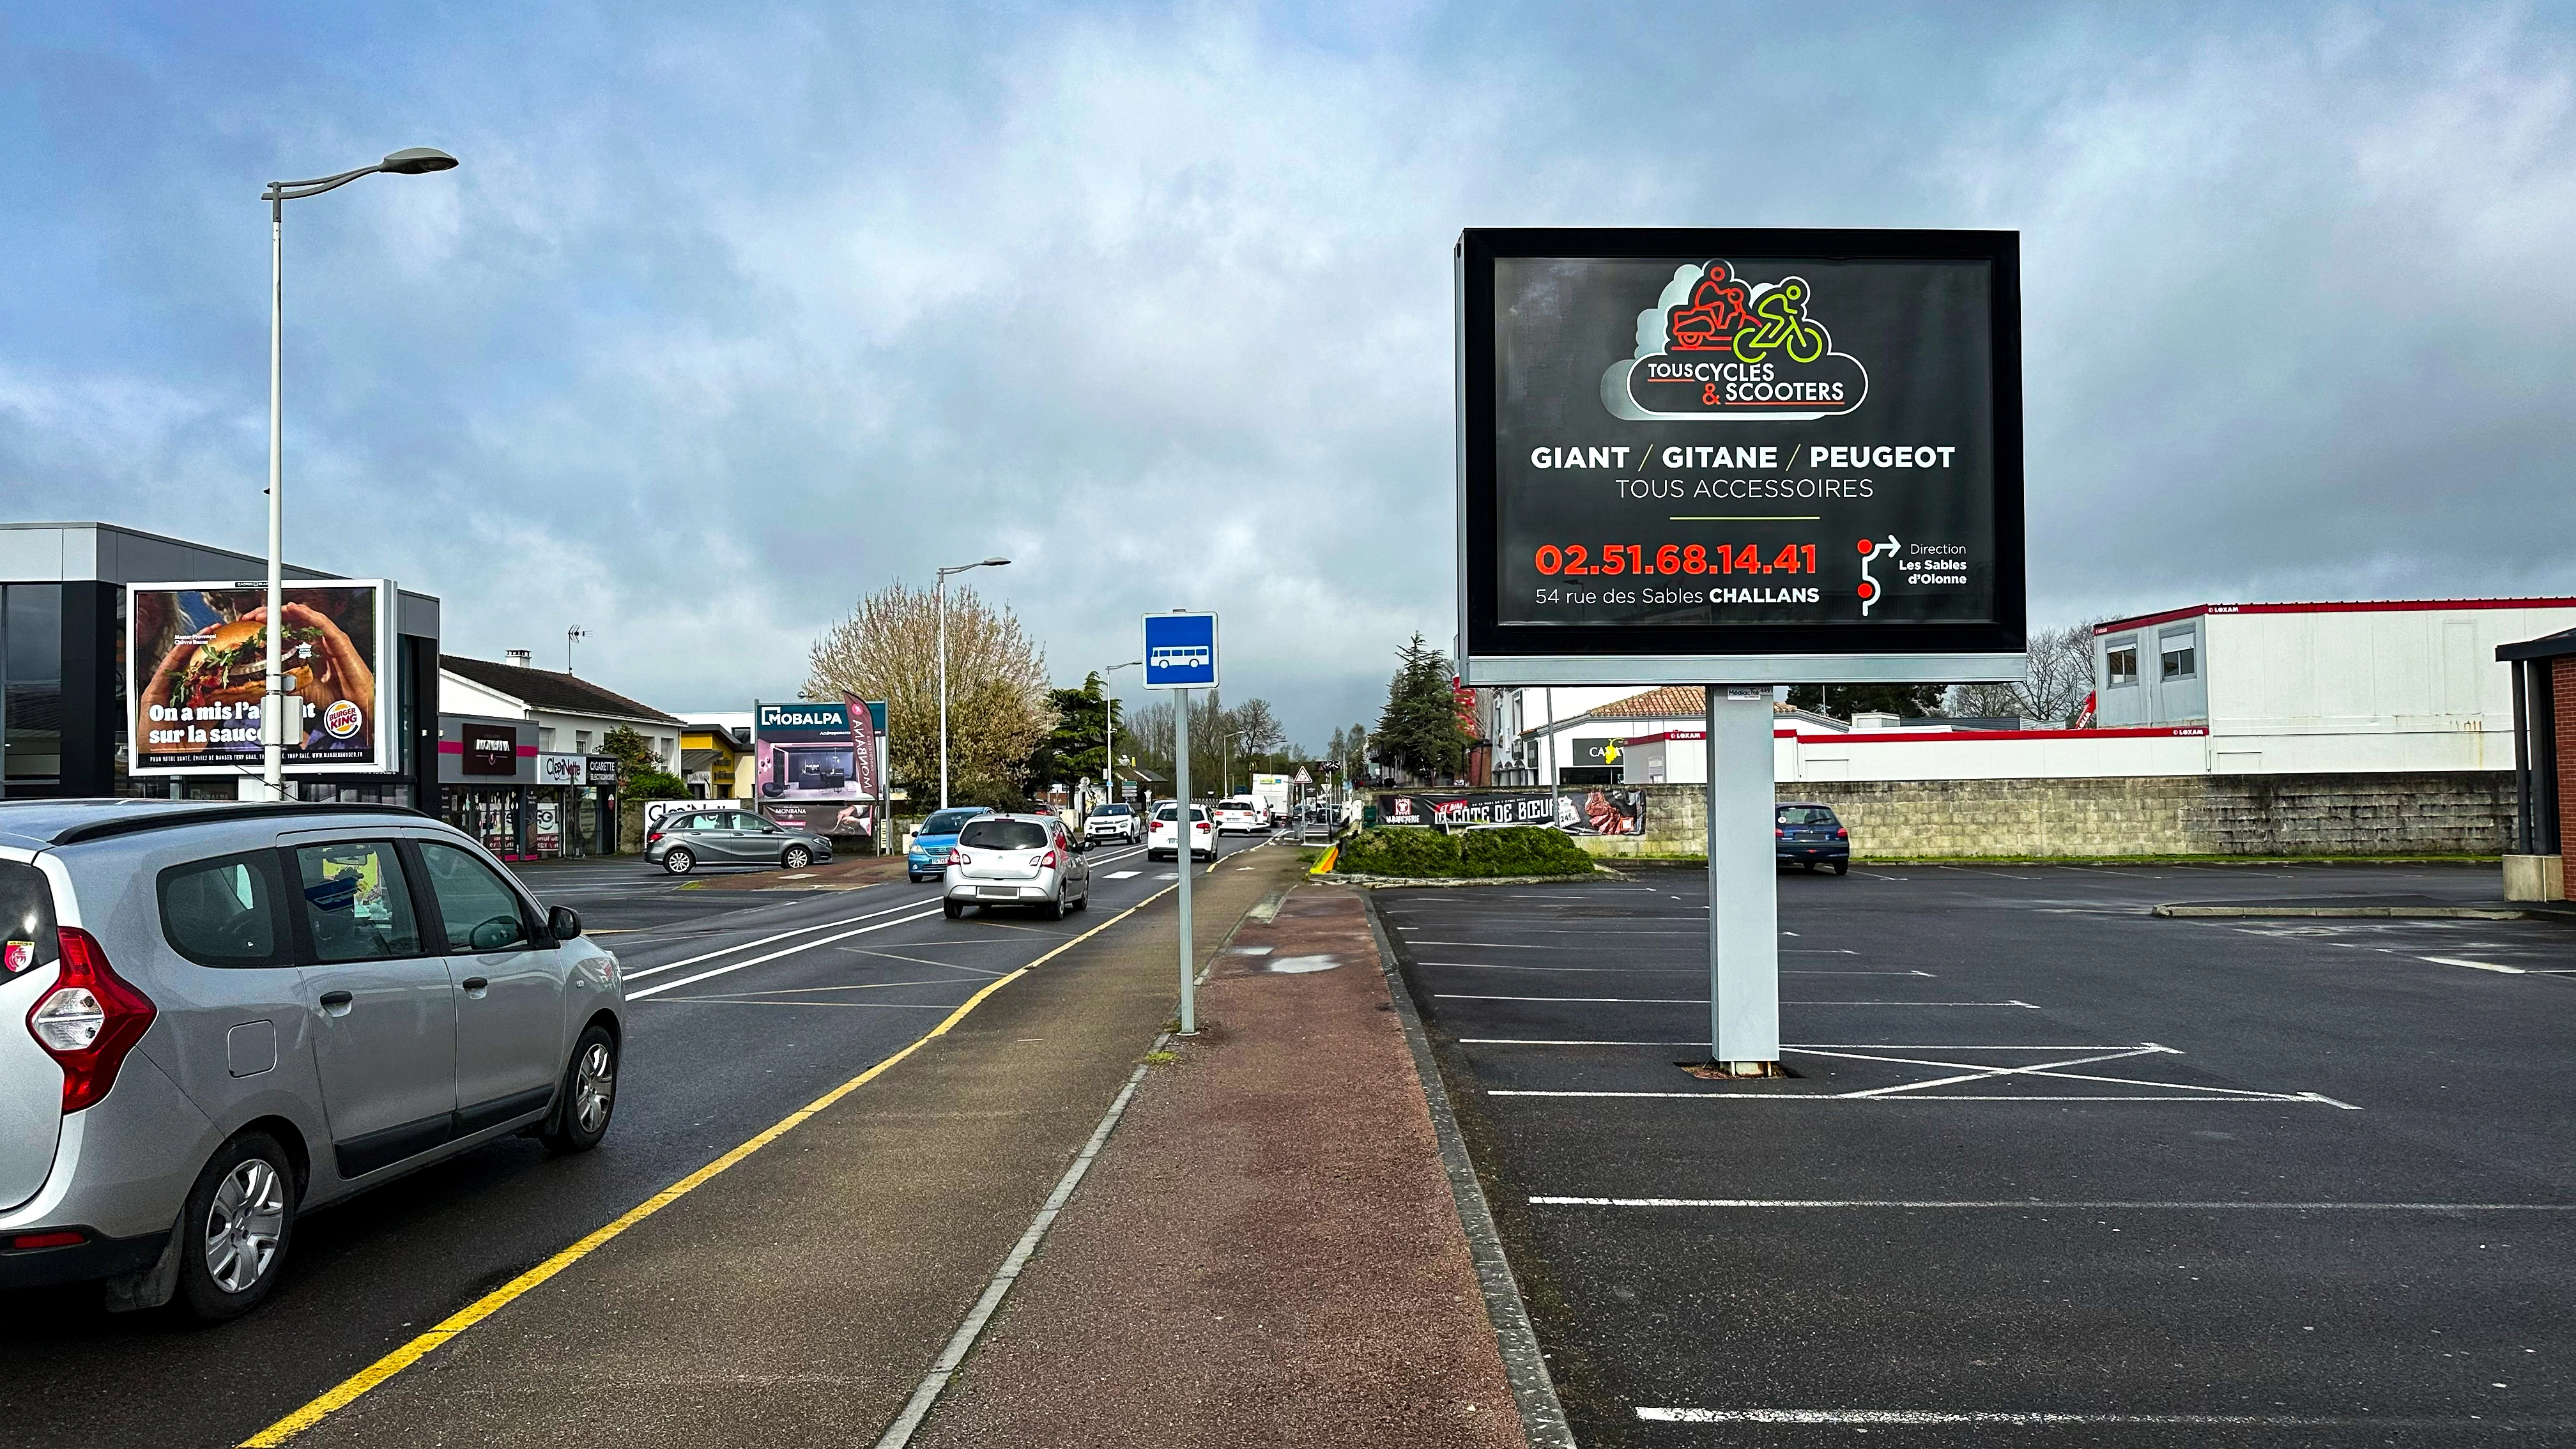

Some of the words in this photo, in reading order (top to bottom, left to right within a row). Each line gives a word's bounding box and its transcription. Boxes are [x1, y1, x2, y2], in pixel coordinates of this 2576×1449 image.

[1702, 383, 1721, 405] &
[1725, 382, 1844, 401] SCOOTERS
[1531, 447, 1630, 468] GIANT
[1662, 447, 1777, 468] GITANE
[1811, 446, 1955, 468] PEUGEOT
[1615, 480, 1684, 498] TOUS
[1693, 479, 1873, 498] ACCESSOIRES
[1910, 544, 1966, 554] Direction
[1535, 544, 1816, 575] 02.51.68.14.41
[1899, 560, 1921, 571] Les
[1924, 559, 1967, 571] Sables
[1908, 573, 1967, 584] d'Olonne
[1536, 589, 1559, 604] 54
[1566, 592, 1596, 604] rue
[1603, 588, 1635, 604] des
[1642, 588, 1703, 604] Sables
[1709, 588, 1820, 603] CHALLANS
[149, 704, 180, 721] On
[181, 706, 195, 721] a
[196, 702, 232, 721] mis
[329, 707, 356, 721] BURGER
[769, 712, 843, 725] MOBALPA
[330, 714, 357, 730] KING
[149, 729, 185, 744] sur
[188, 725, 208, 743] la
[590, 761, 615, 771] CIGARETTE
[1495, 804, 1512, 823] DE
